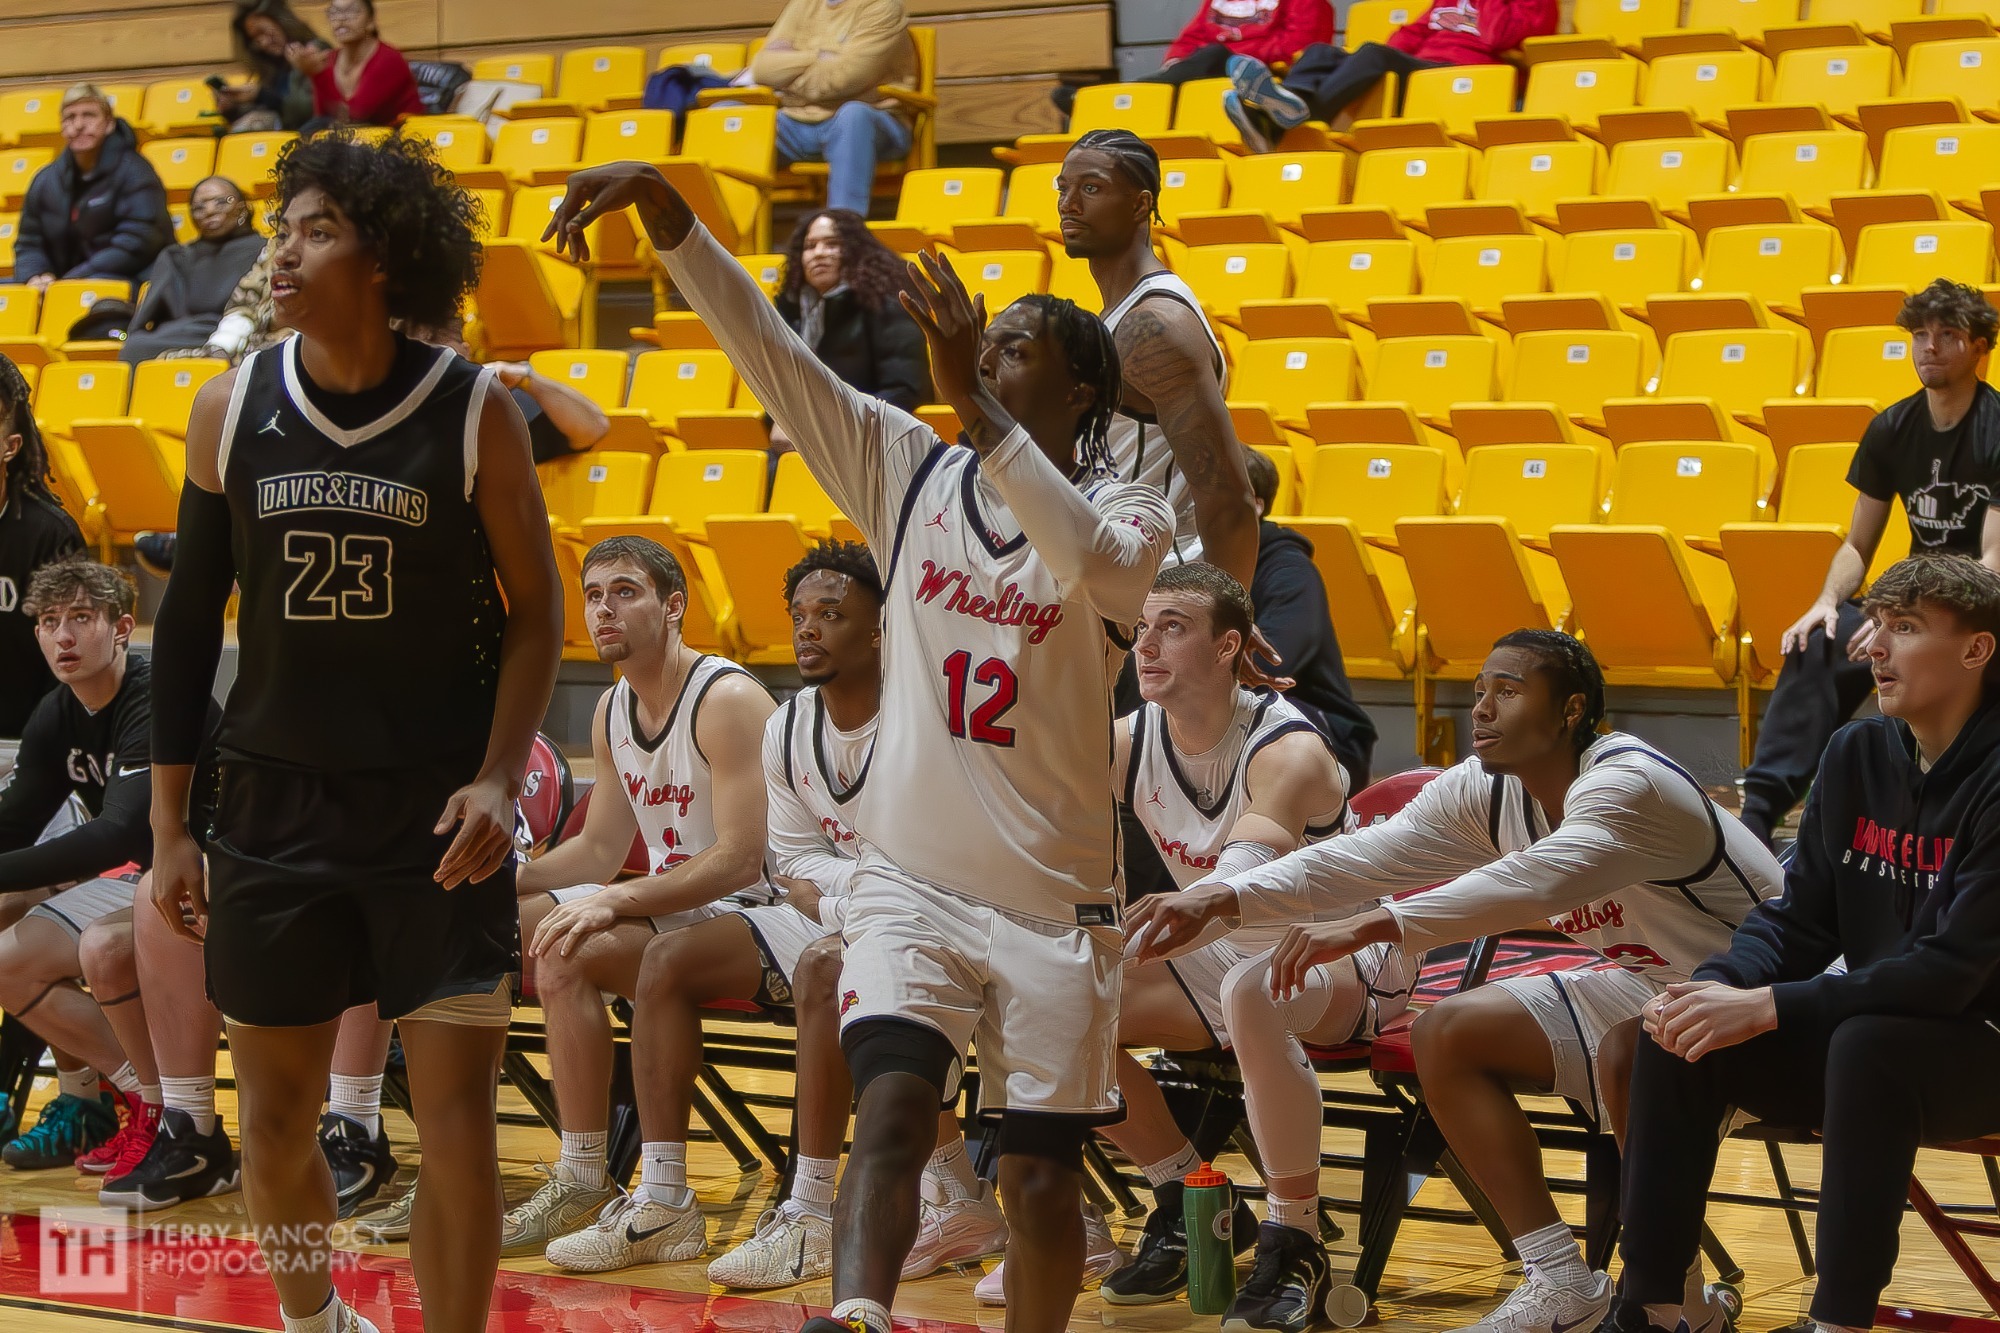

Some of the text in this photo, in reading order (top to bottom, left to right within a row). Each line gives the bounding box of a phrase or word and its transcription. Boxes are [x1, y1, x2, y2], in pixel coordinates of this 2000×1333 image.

[262, 476, 422, 522] DAVIS&ELKINS
[284, 530, 393, 620] 23
[915, 559, 1065, 645] Wheeling
[942, 649, 1020, 748] 12
